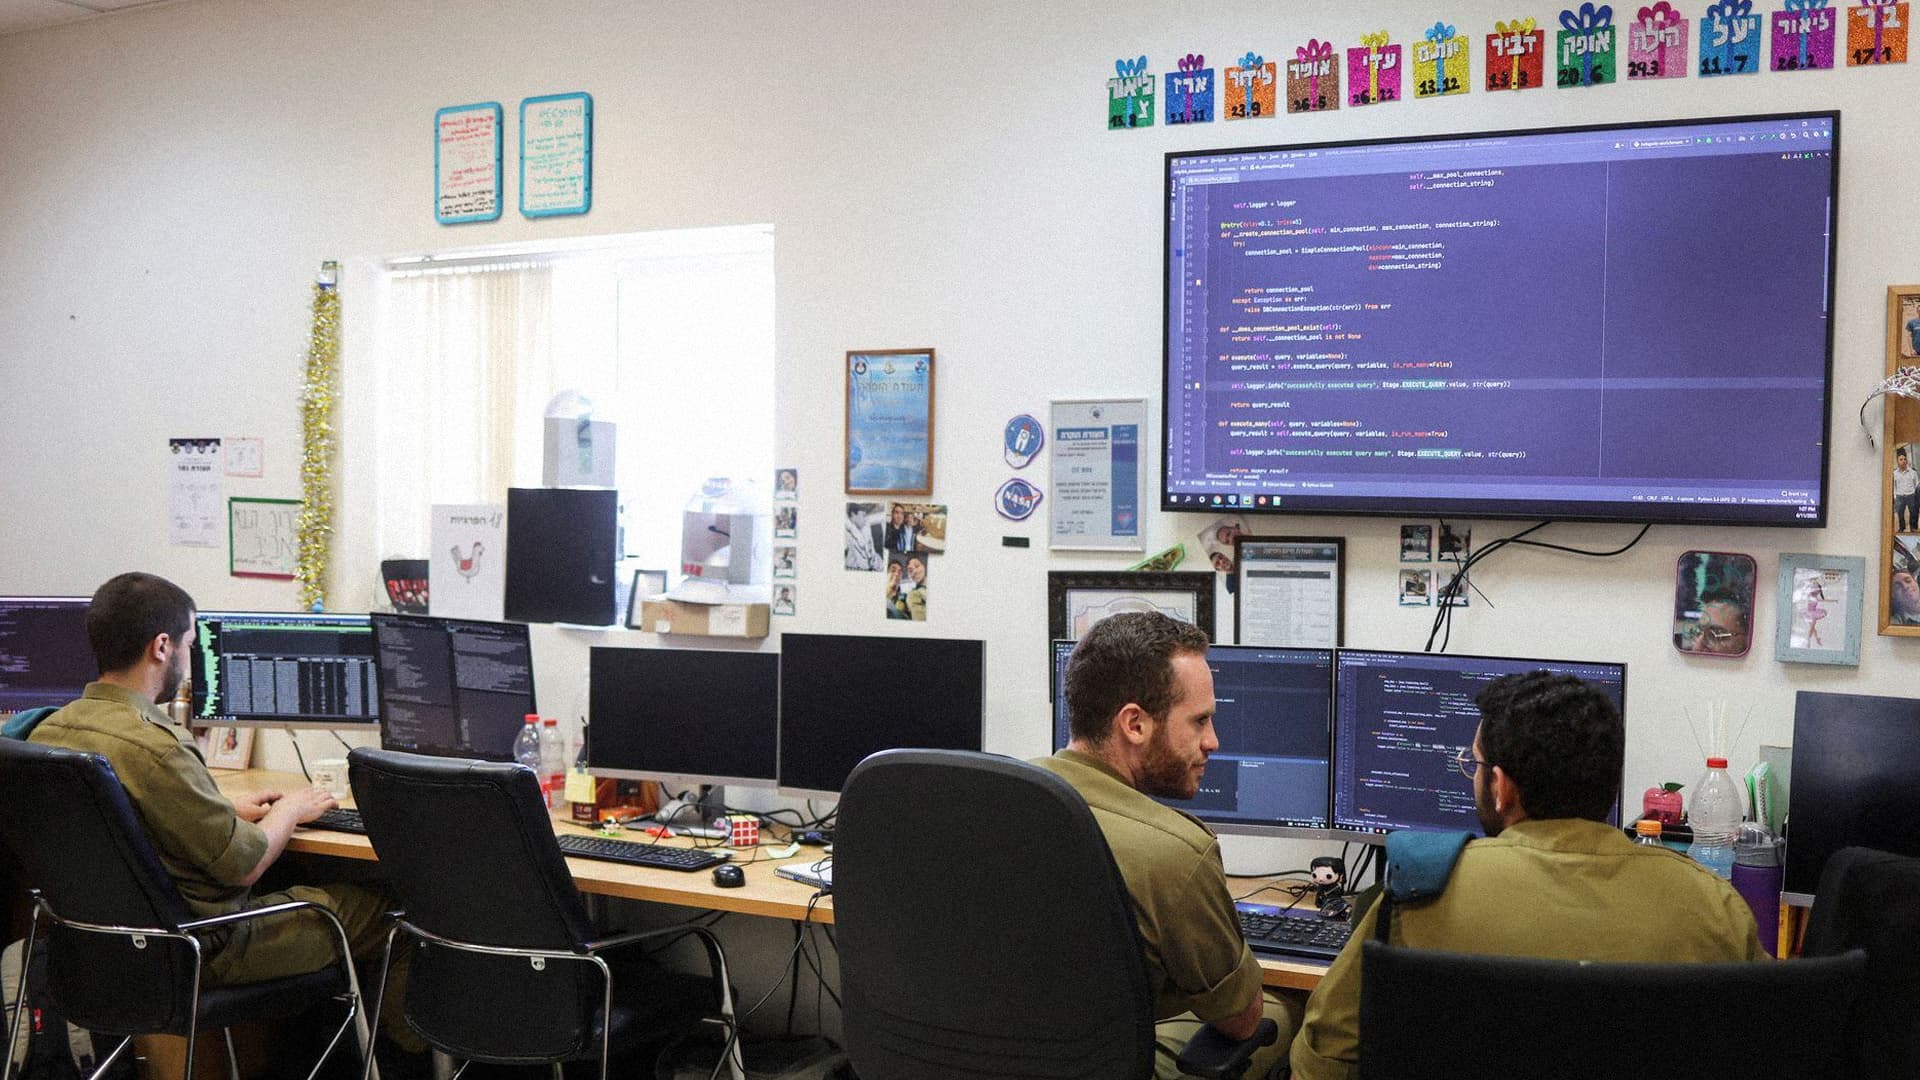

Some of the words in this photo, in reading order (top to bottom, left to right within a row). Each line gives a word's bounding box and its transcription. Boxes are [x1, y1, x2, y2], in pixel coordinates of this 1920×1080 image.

[1778, 12, 1829, 34] ליאור
[1857, 6, 1900, 28] בר
[1634, 18, 1680, 52] הילה
[1713, 12, 1755, 47] יעל
[1418, 42, 1459, 62] יותם
[1491, 35, 1536, 56] דביר
[1563, 31, 1610, 65] אופק
[1289, 60, 1330, 79] אופיר
[1362, 53, 1396, 69] עדי
[1701, 55, 1748, 74] 11.7
[1778, 55, 1816, 70] 26.2
[1106, 71, 1154, 99] ליאור
[1229, 65, 1272, 87] לידור
[1558, 65, 1602, 85] 20.6
[1419, 78, 1460, 95] 13.12
[1004, 492, 1030, 508] NASA
